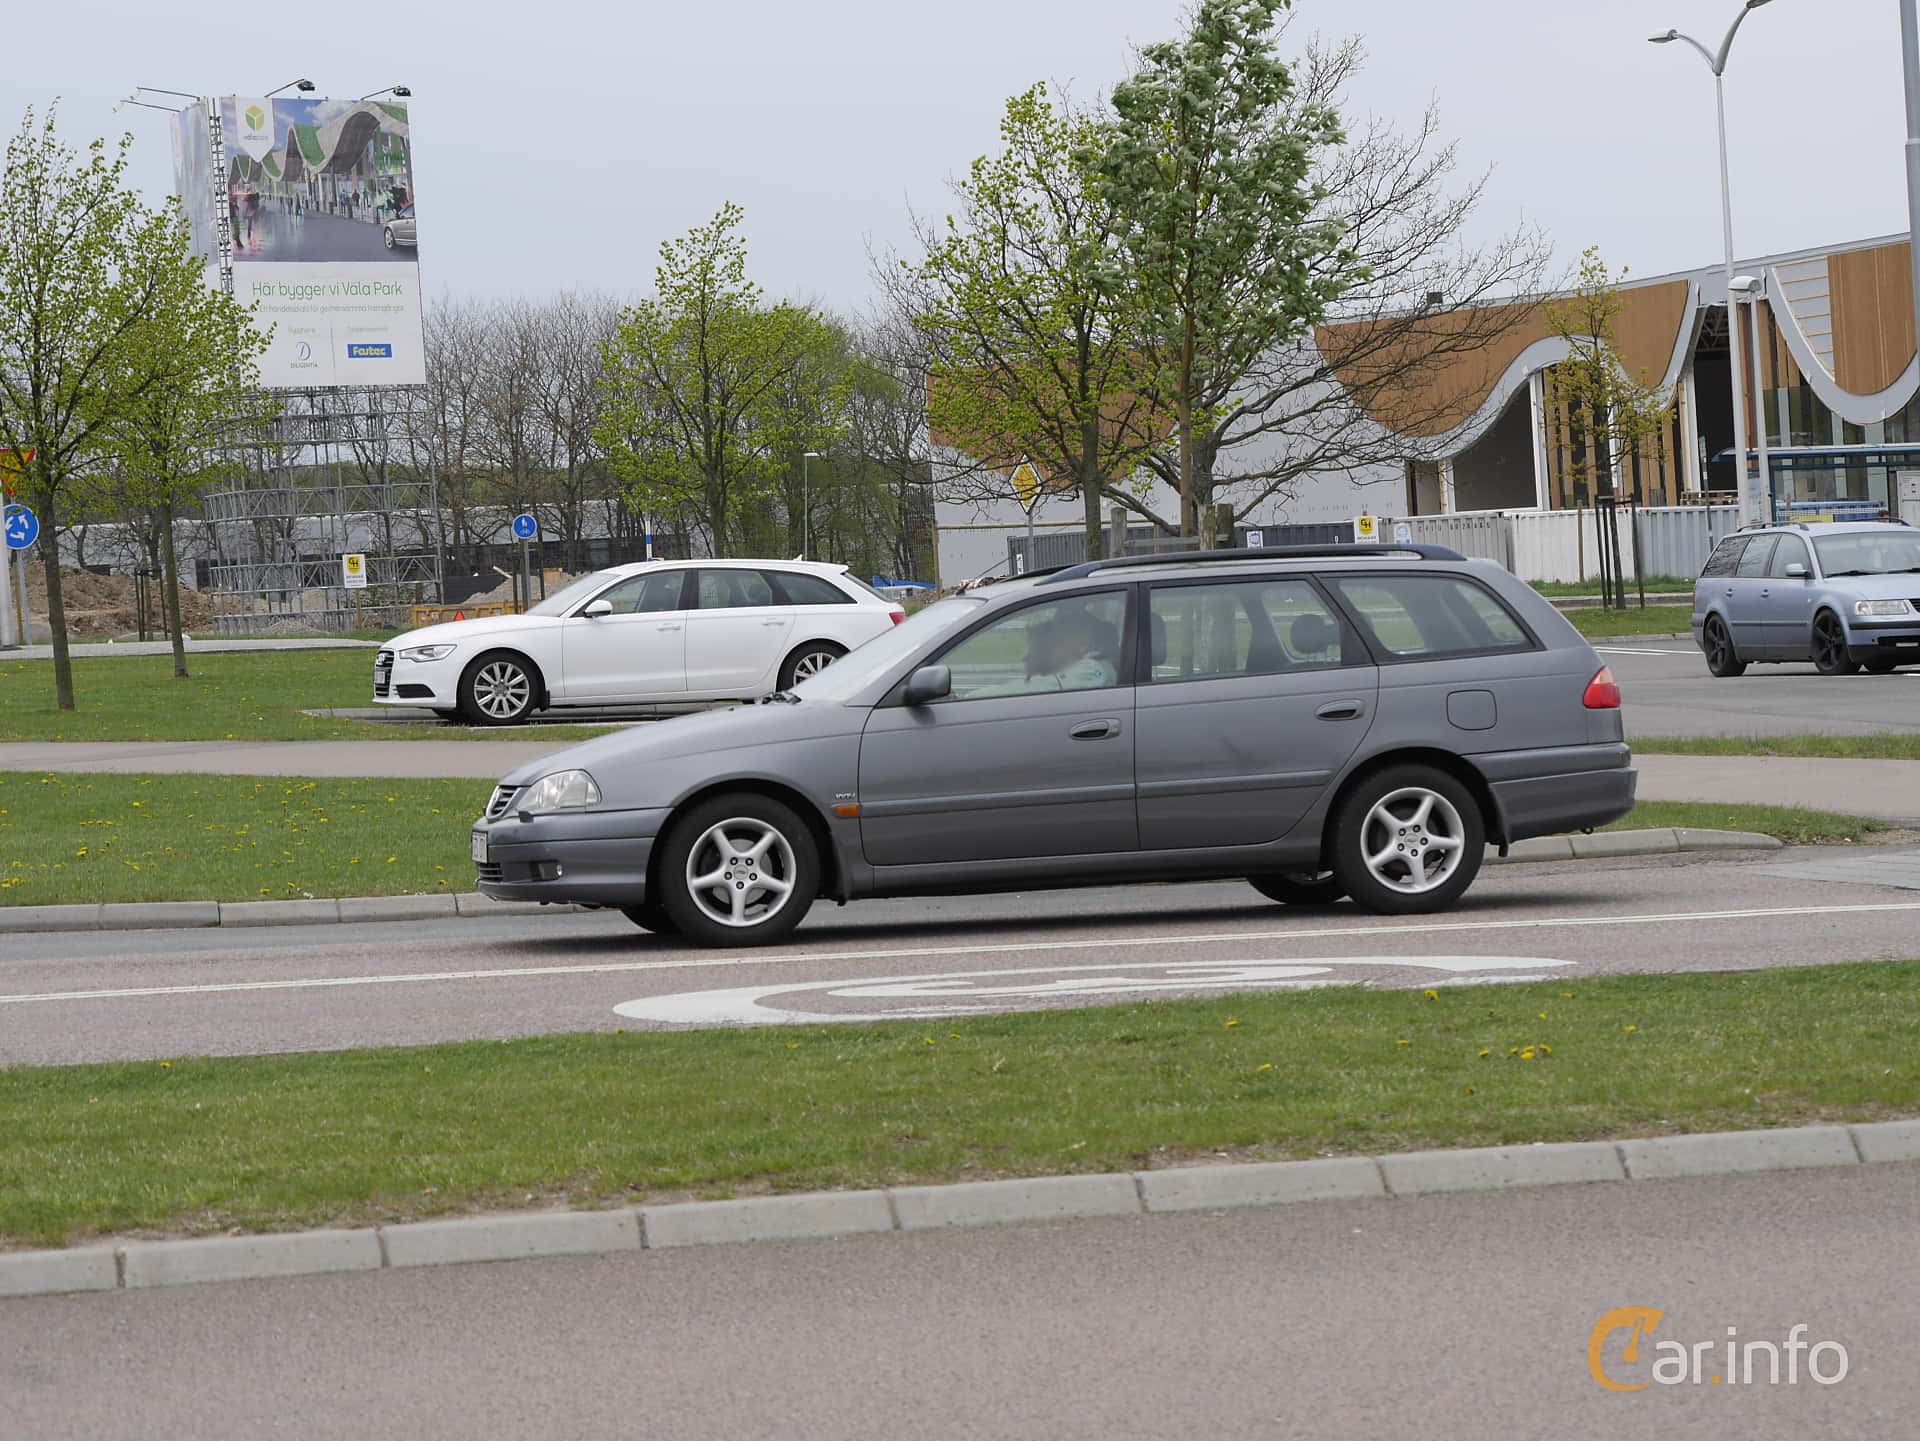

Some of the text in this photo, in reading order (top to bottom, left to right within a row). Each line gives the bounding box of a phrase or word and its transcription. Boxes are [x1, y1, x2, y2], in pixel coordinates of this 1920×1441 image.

[253, 280, 402, 300] Här bygger vi Väla Park
